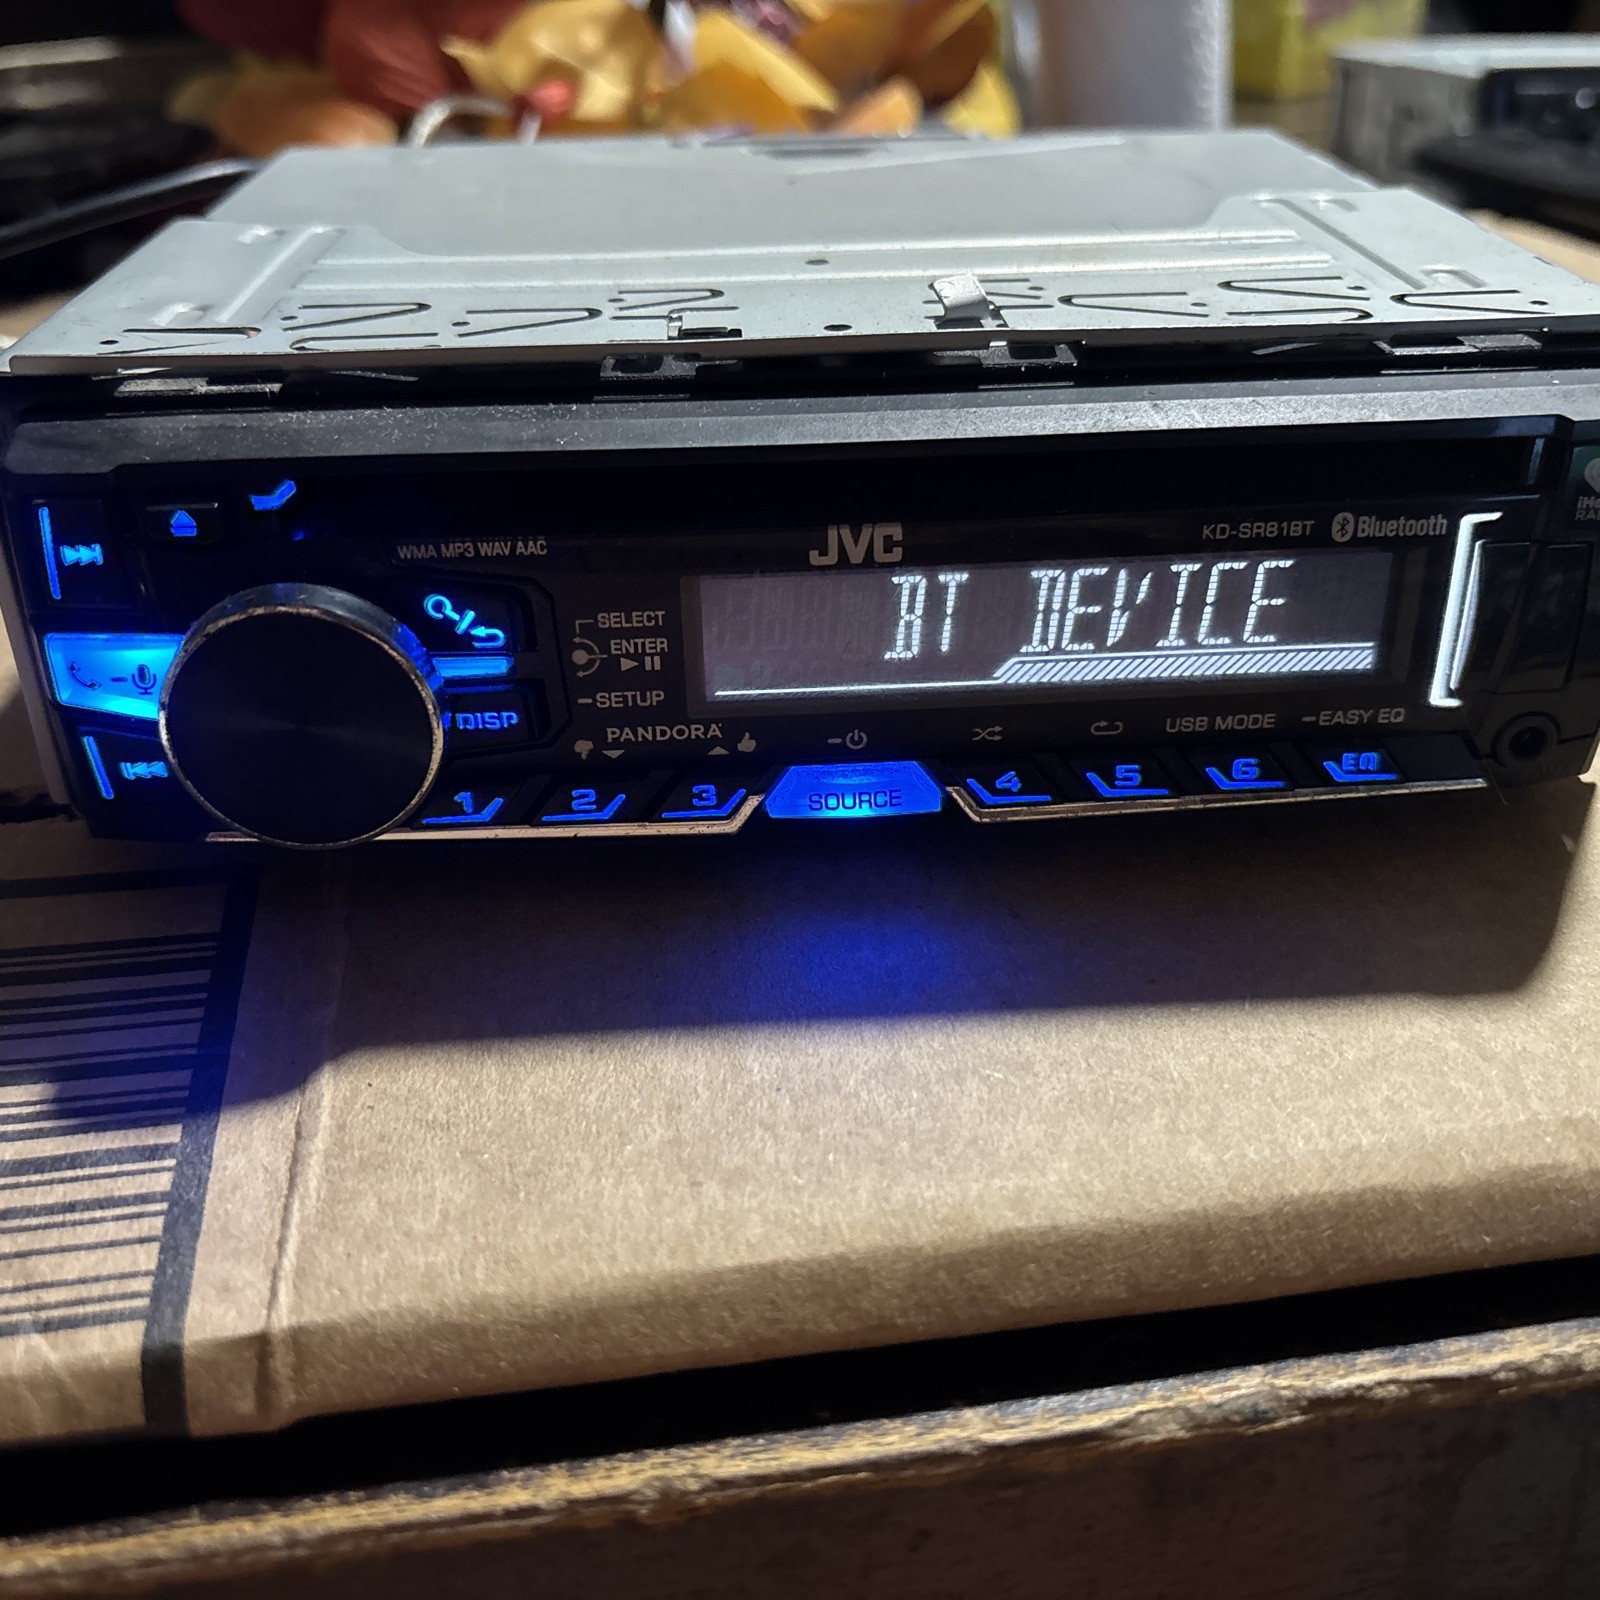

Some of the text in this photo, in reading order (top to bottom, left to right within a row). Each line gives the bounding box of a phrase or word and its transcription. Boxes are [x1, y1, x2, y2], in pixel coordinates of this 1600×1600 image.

[1202, 520, 1315, 541] KD-SR81BT
[1357, 513, 1448, 538] Bluetooth
[397, 539, 548, 560] WMA MP3 WAV AAC
[808, 523, 904, 566] JVC
[596, 611, 666, 629] SELECT
[883, 559, 1296, 661] BT DEVICE
[610, 638, 669, 654] ENTER
[455, 711, 519, 730] DISP
[1165, 713, 1277, 734] USB MODE
[1377, 707, 1405, 725] EQ
[606, 724, 723, 743] PANDORA
[1115, 764, 1142, 787] 5
[1232, 758, 1260, 781] 6
[995, 771, 1022, 792] 4
[453, 791, 474, 813] 1
[571, 789, 597, 810] 2
[692, 785, 717, 806] 3
[808, 789, 903, 812] SOURCE
